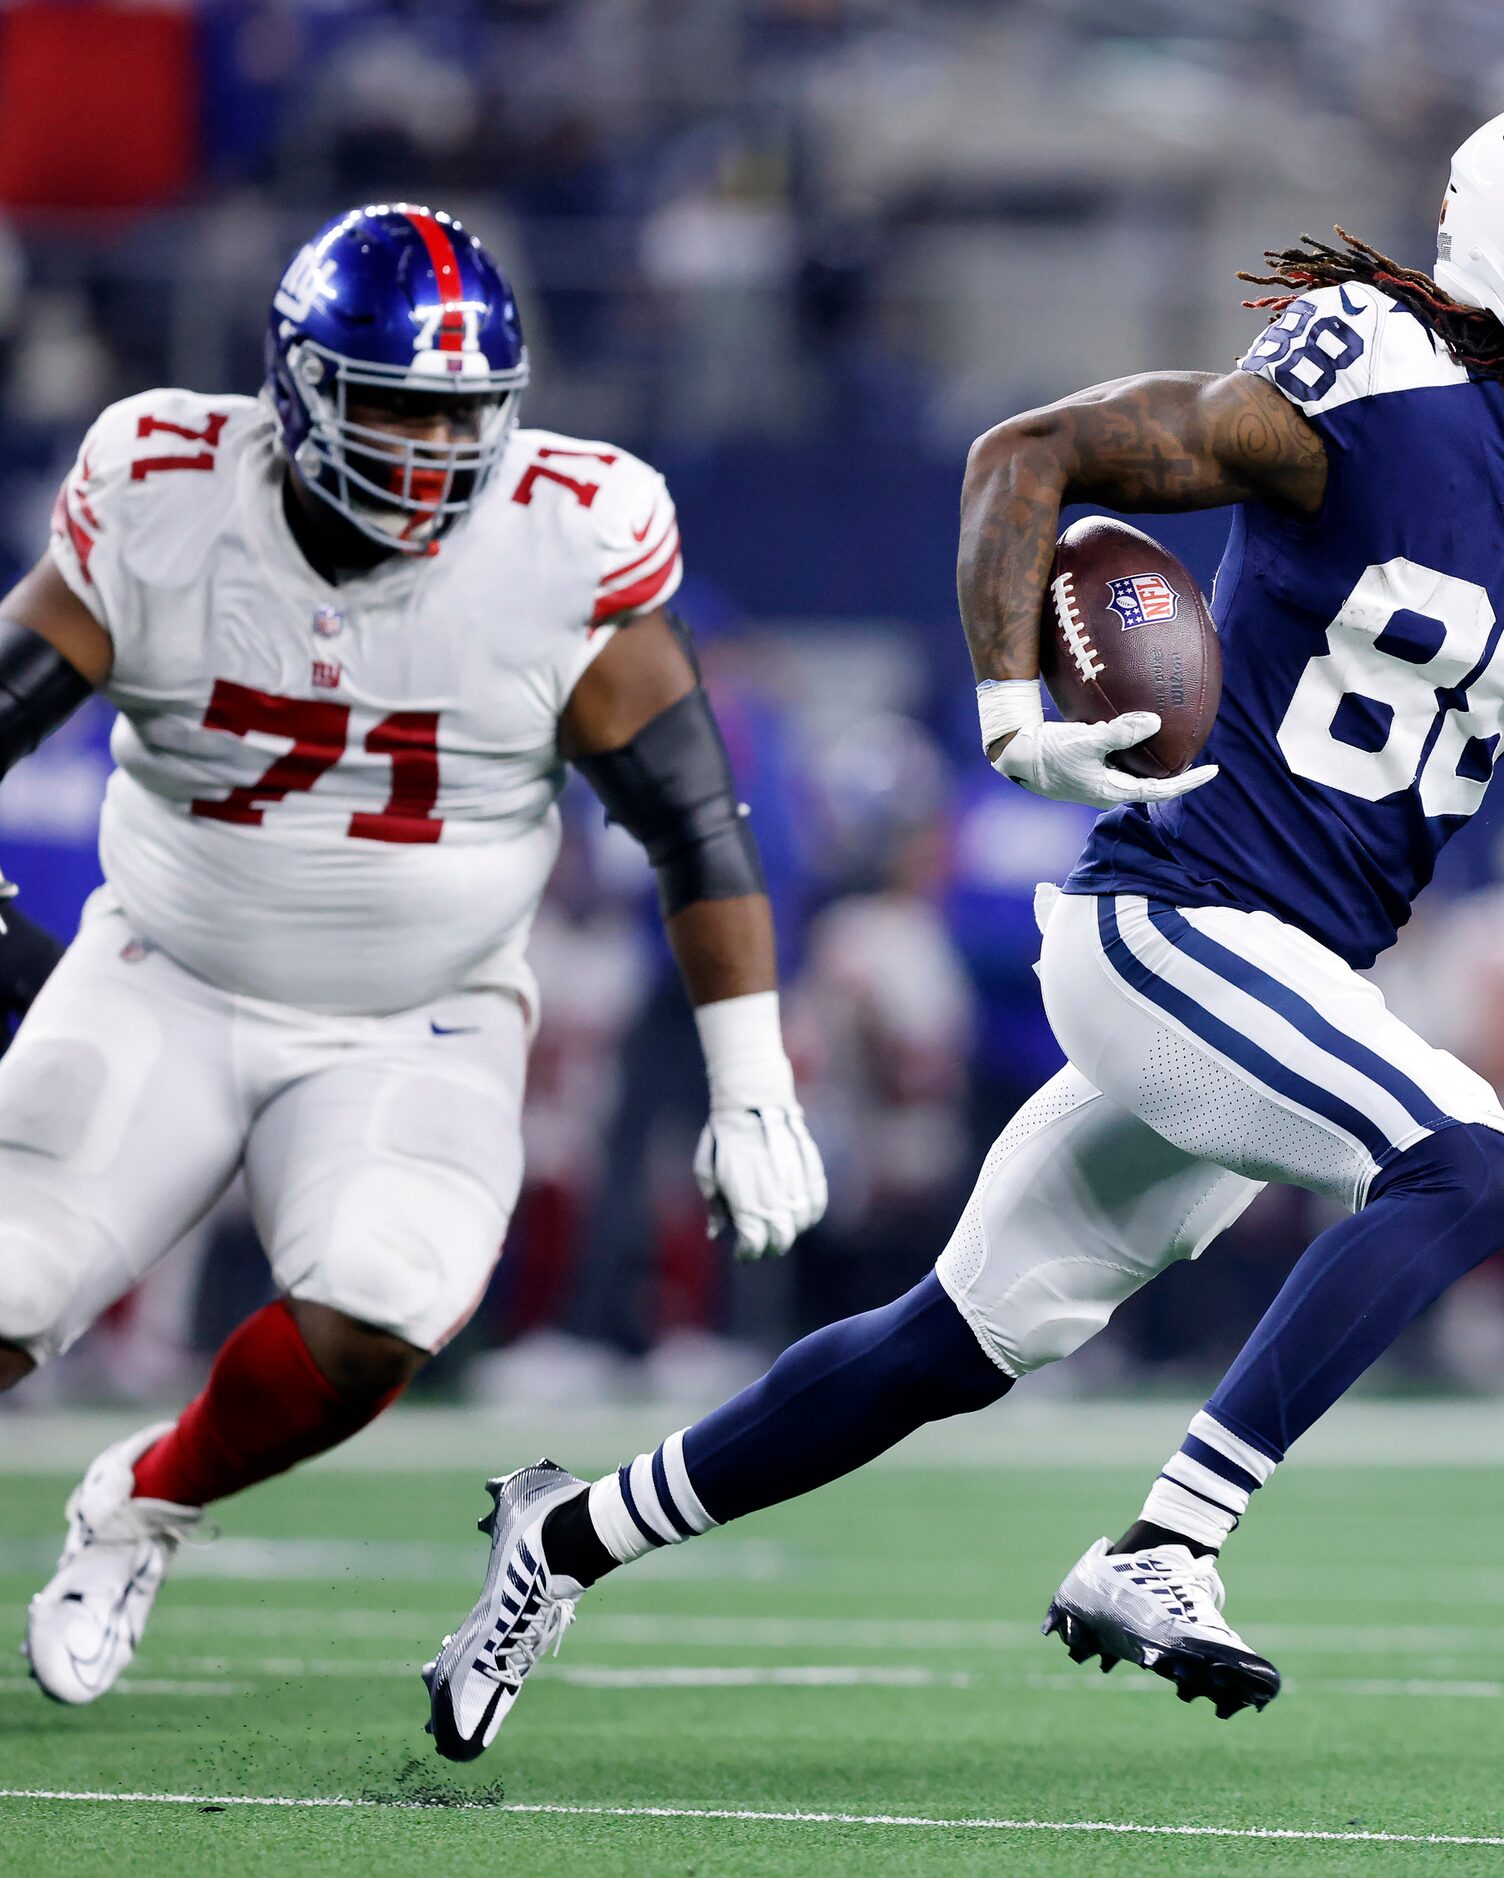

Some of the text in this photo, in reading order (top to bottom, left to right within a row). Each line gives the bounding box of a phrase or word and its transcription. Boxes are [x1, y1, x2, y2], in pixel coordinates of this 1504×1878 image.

[408, 301, 493, 351] 71
[1241, 299, 1364, 402] 88
[130, 411, 229, 481] 71
[512, 448, 618, 508] 71
[1136, 577, 1172, 618] NFL
[191, 677, 446, 844] 71
